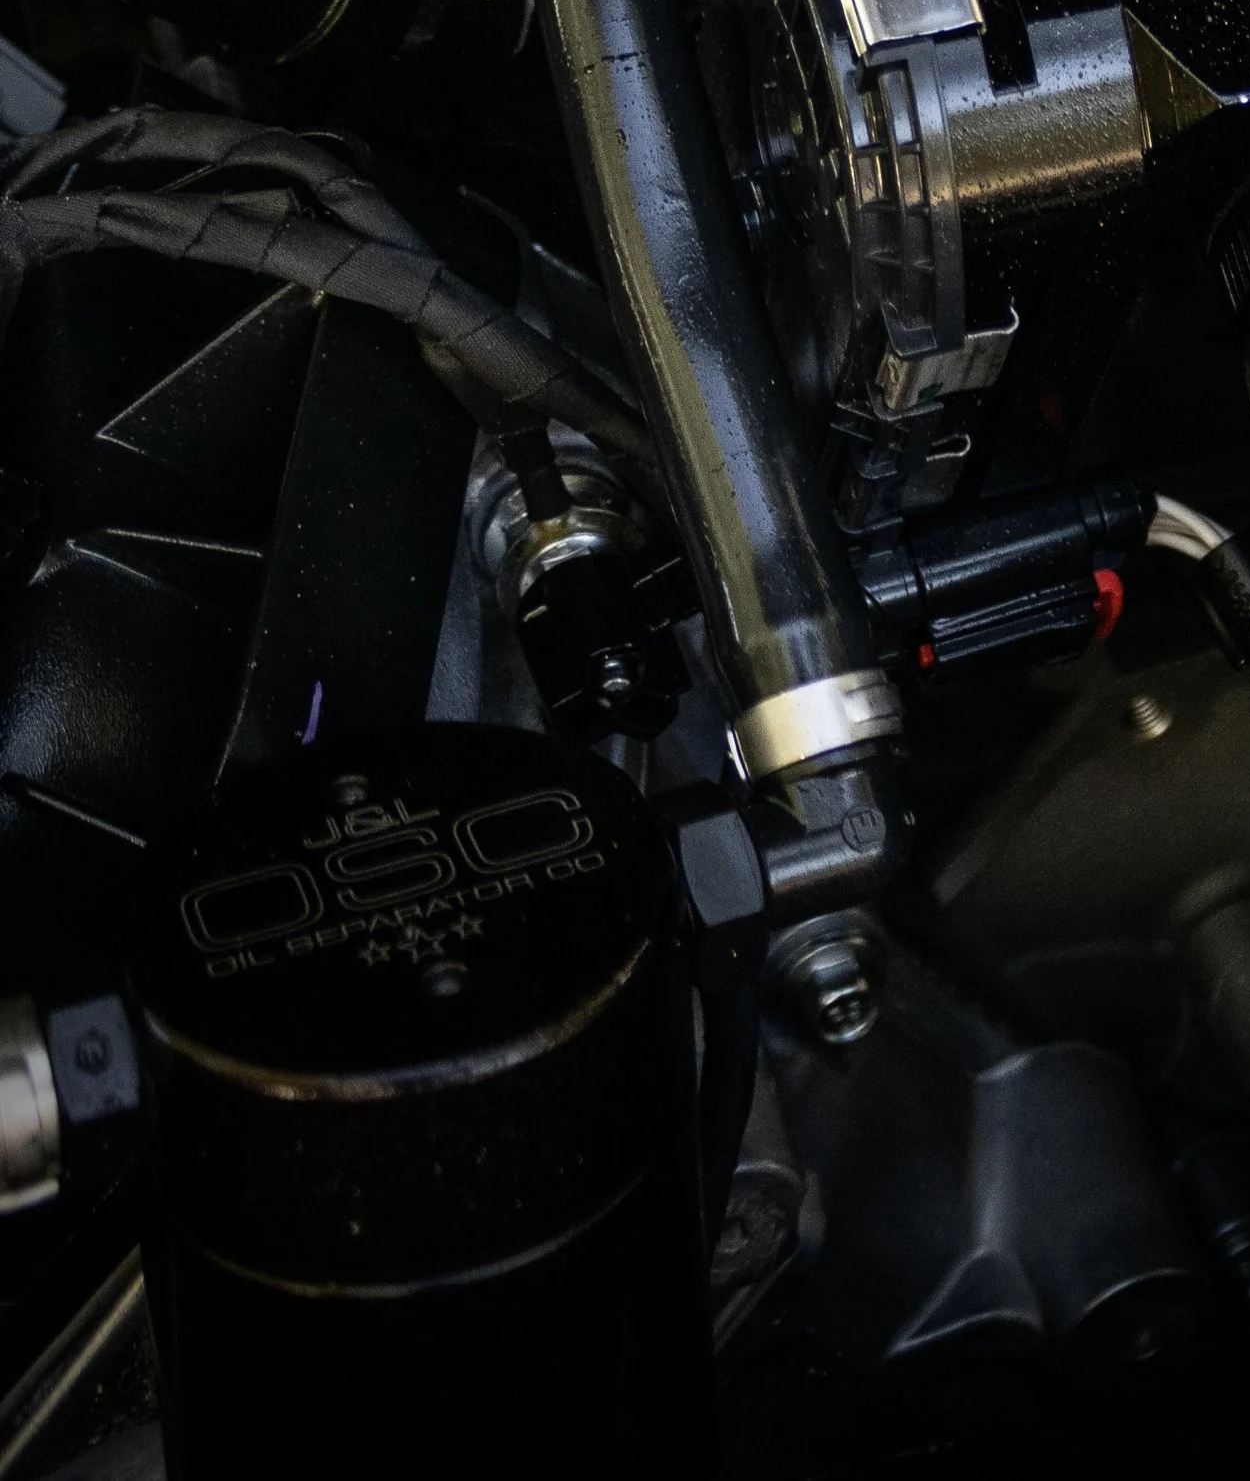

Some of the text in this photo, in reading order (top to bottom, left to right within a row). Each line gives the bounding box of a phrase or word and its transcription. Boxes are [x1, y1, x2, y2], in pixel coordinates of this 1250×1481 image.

[179, 786, 595, 953] OSC
[301, 797, 441, 850] J&L
[205, 949, 276, 980] OIL
[285, 872, 536, 958] SEPARATOR
